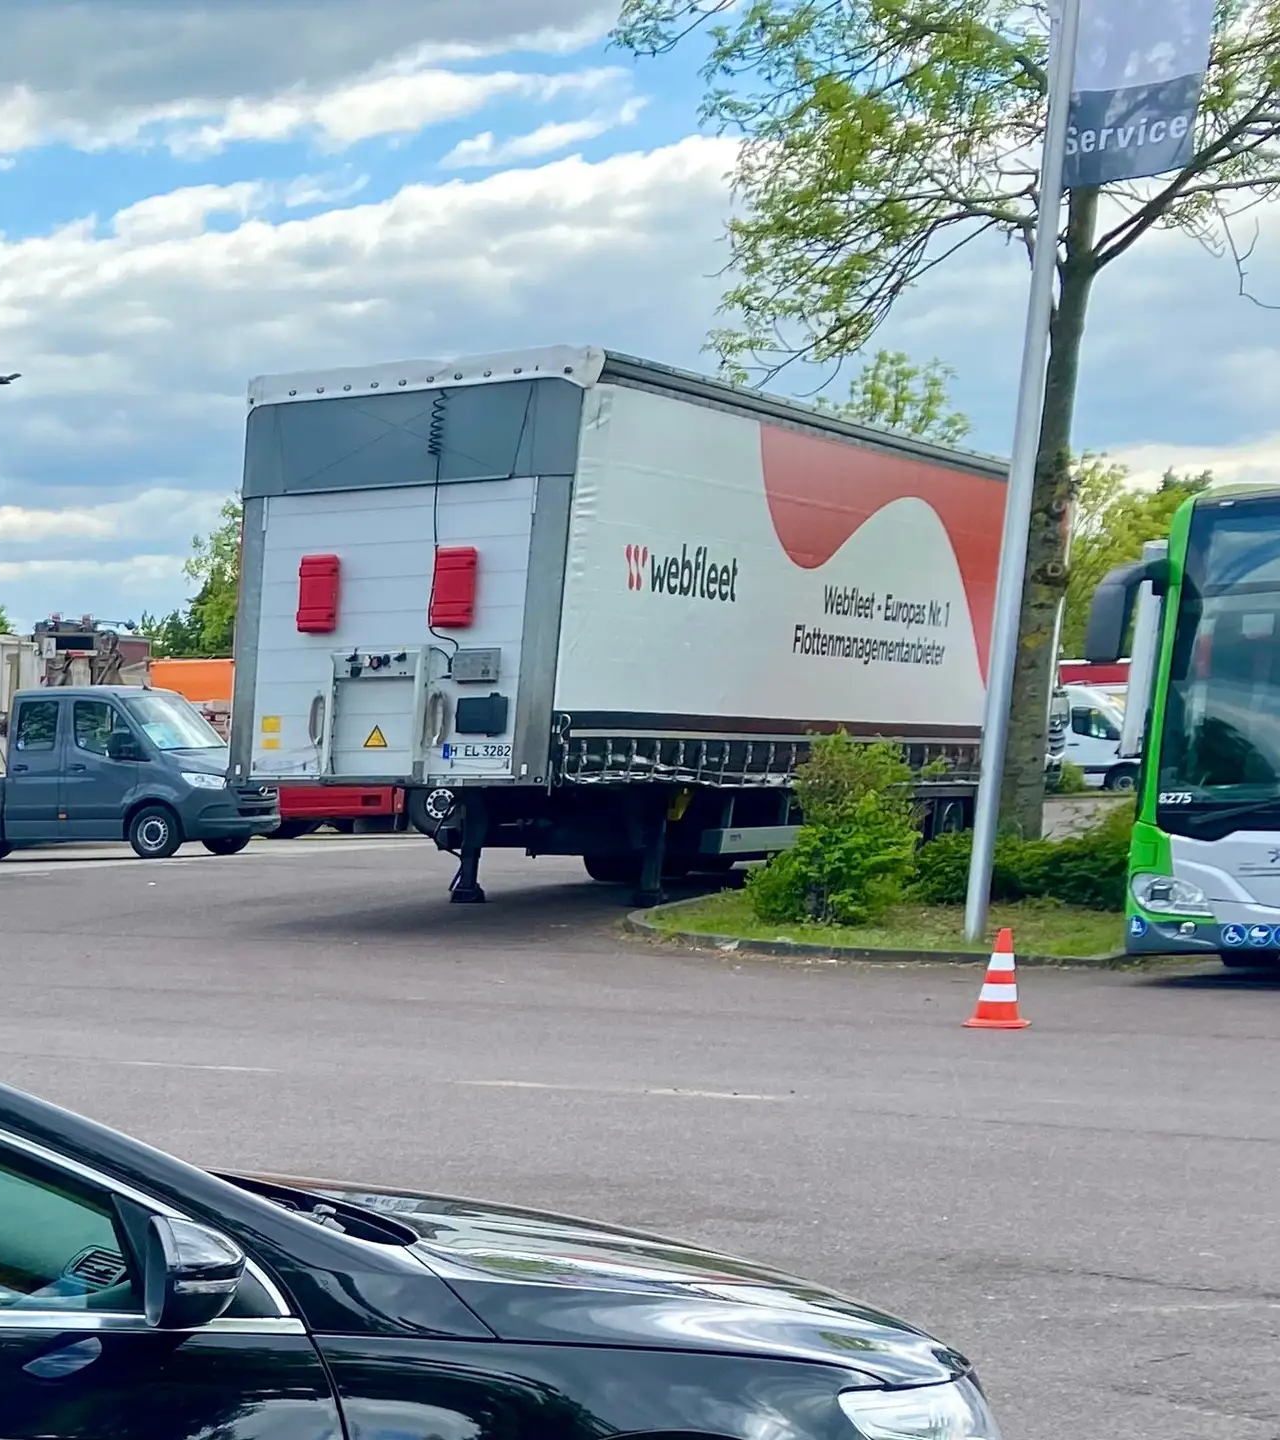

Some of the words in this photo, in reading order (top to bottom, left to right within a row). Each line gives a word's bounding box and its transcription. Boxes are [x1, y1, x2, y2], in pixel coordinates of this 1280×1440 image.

[1065, 115, 1188, 156] Service
[651, 543, 738, 602] webfleet
[824, 584, 875, 620] Webfleet
[884, 594, 926, 629] Europas
[927, 600, 942, 627] Nr.
[944, 601, 951, 628] 1
[44, 640, 54, 656] A
[793, 624, 946, 665] Flottenmanagementanbieter
[450, 745, 458, 756] H
[464, 745, 480, 757] EL
[482, 745, 511, 757] 3282
[1158, 792, 1192, 804] 8275
